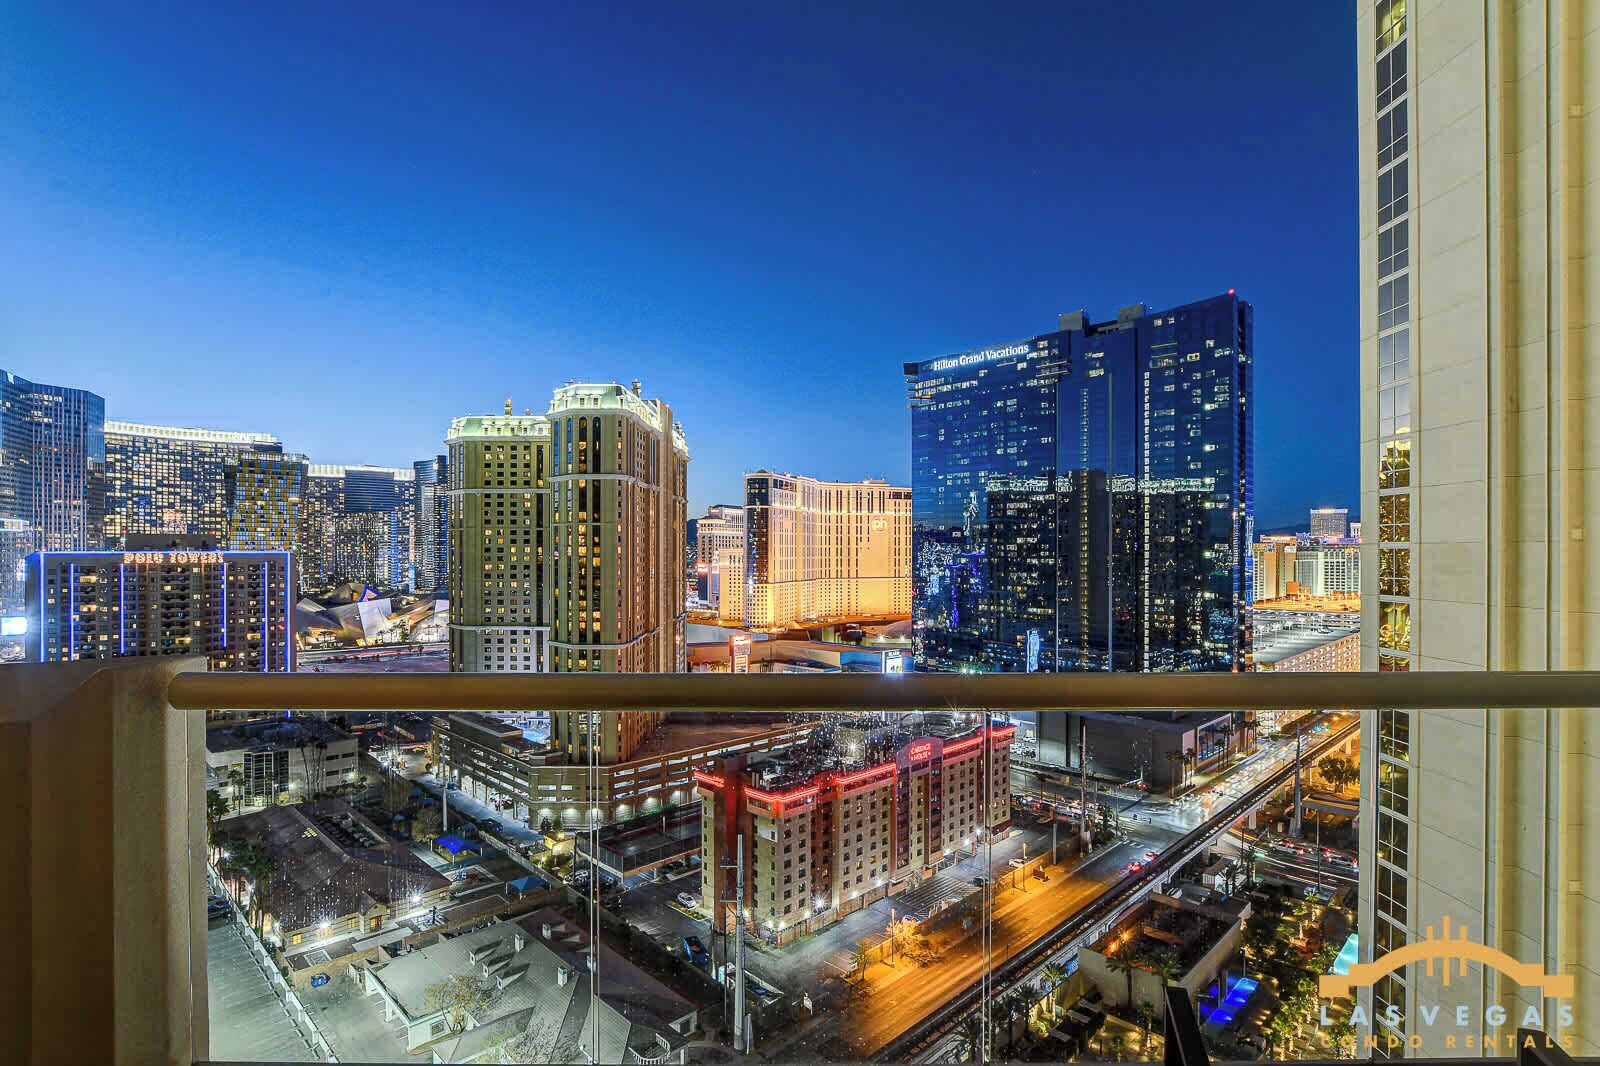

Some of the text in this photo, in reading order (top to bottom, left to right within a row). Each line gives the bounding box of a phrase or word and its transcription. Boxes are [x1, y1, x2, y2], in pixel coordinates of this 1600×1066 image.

[934, 344, 1030, 371] Hilton Grand Vacations
